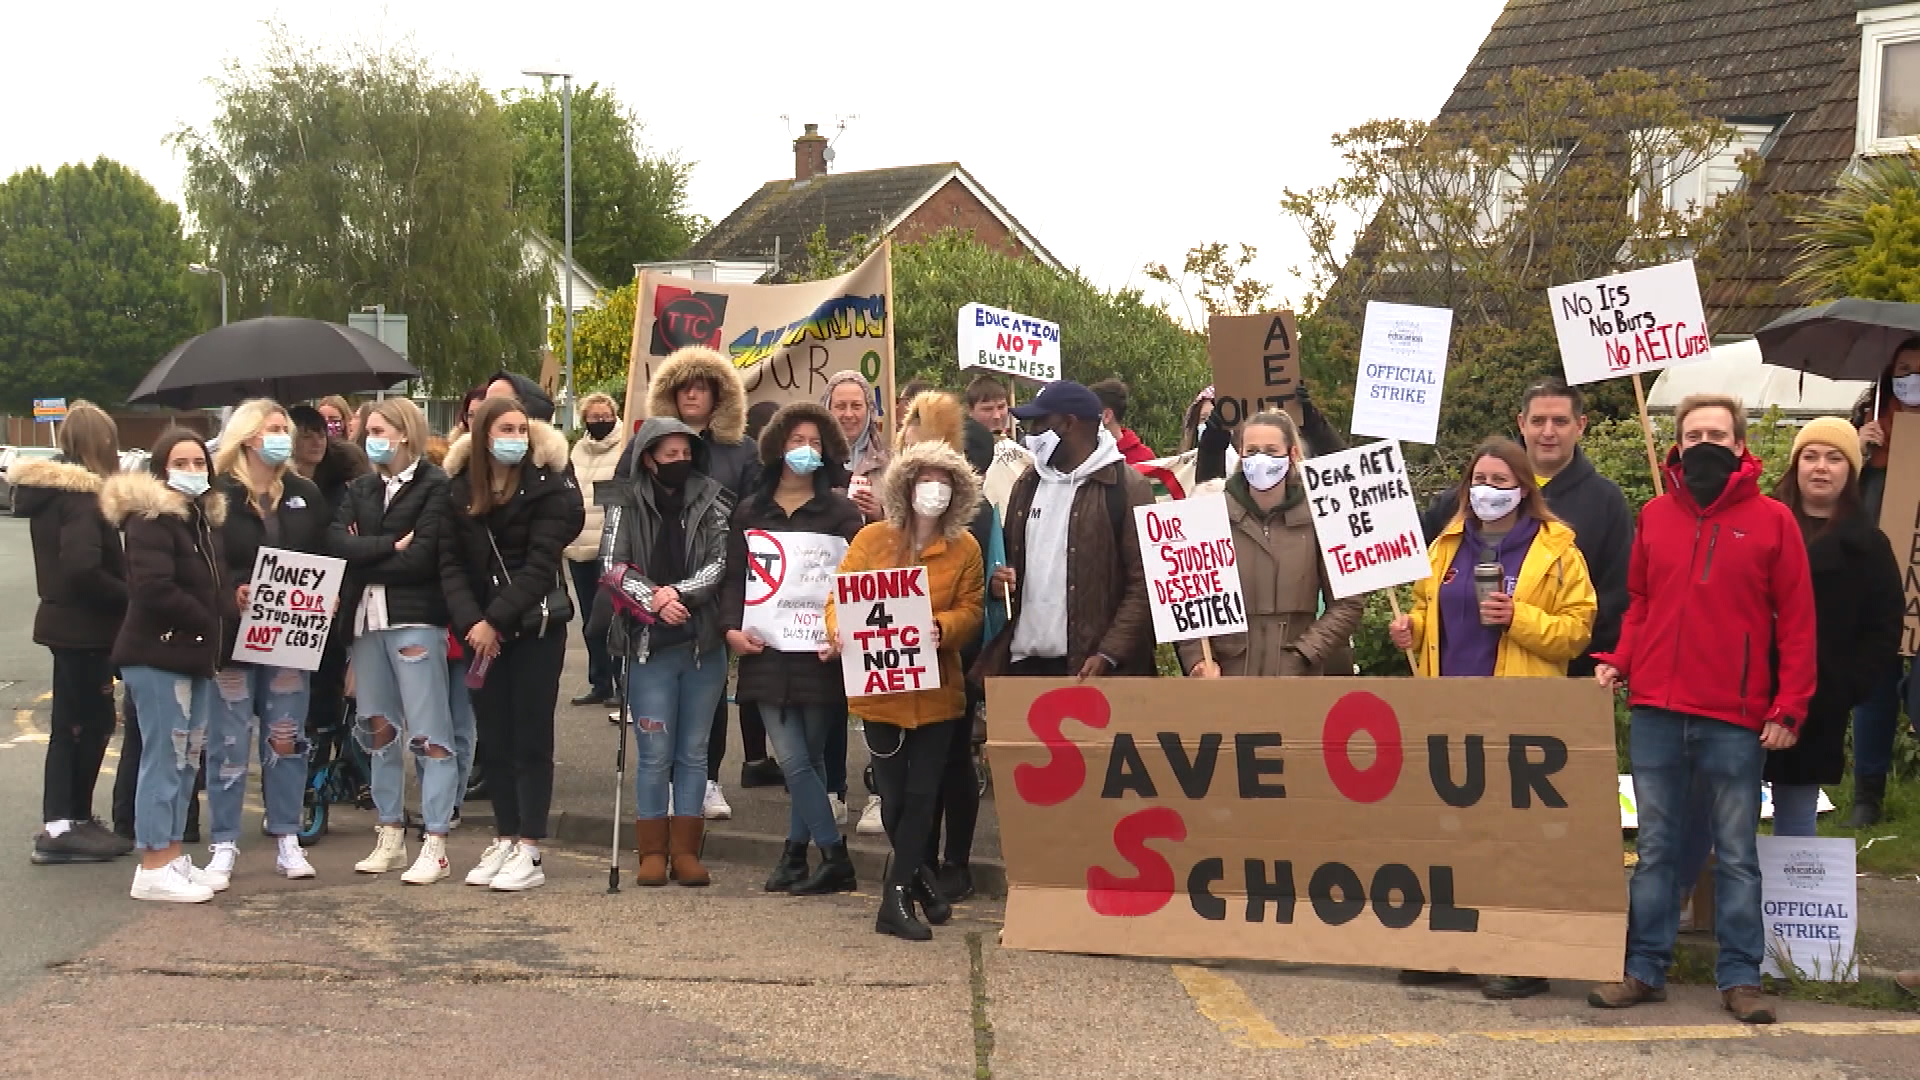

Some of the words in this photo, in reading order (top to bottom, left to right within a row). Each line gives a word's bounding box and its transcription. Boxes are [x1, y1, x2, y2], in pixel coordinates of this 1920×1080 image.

[1562, 291, 1593, 320] NO
[667, 311, 712, 339] TTC
[975, 307, 1059, 342] EDUCATION
[1588, 314, 1613, 337] NO
[996, 332, 1043, 357] NOT
[1605, 337, 1631, 368] NO
[1635, 323, 1673, 365] AET
[979, 350, 1055, 379] BUSINESS
[1366, 364, 1436, 385] OFFICIAL
[1370, 384, 1427, 405] STRIKE
[1304, 463, 1357, 491] DEAR
[1312, 494, 1341, 518] I'D
[1349, 477, 1409, 509] RATHER
[1146, 511, 1187, 542] OUR
[1348, 511, 1374, 538] BE
[1160, 538, 1236, 576] STUDENTS
[1327, 530, 1420, 576] TEACHING!
[257, 553, 326, 591] MONEY
[254, 584, 287, 606] FOR
[290, 589, 325, 611] OUR
[838, 569, 925, 604] HONK
[1154, 569, 1223, 605] DESERVE
[794, 613, 822, 626] NOT
[865, 602, 894, 630] 4
[1171, 591, 1244, 633] BETTER!
[246, 626, 283, 648] NOT
[854, 626, 920, 651] TTC
[864, 648, 920, 671] NOT
[865, 666, 926, 693] AET
[1014, 686, 1287, 806] SAVE
[1322, 690, 1568, 809] OUR
[1086, 807, 1479, 932] SCHOOL
[1763, 902, 1848, 918] OFFICIAL
[1773, 923, 1841, 939] STRIKE
